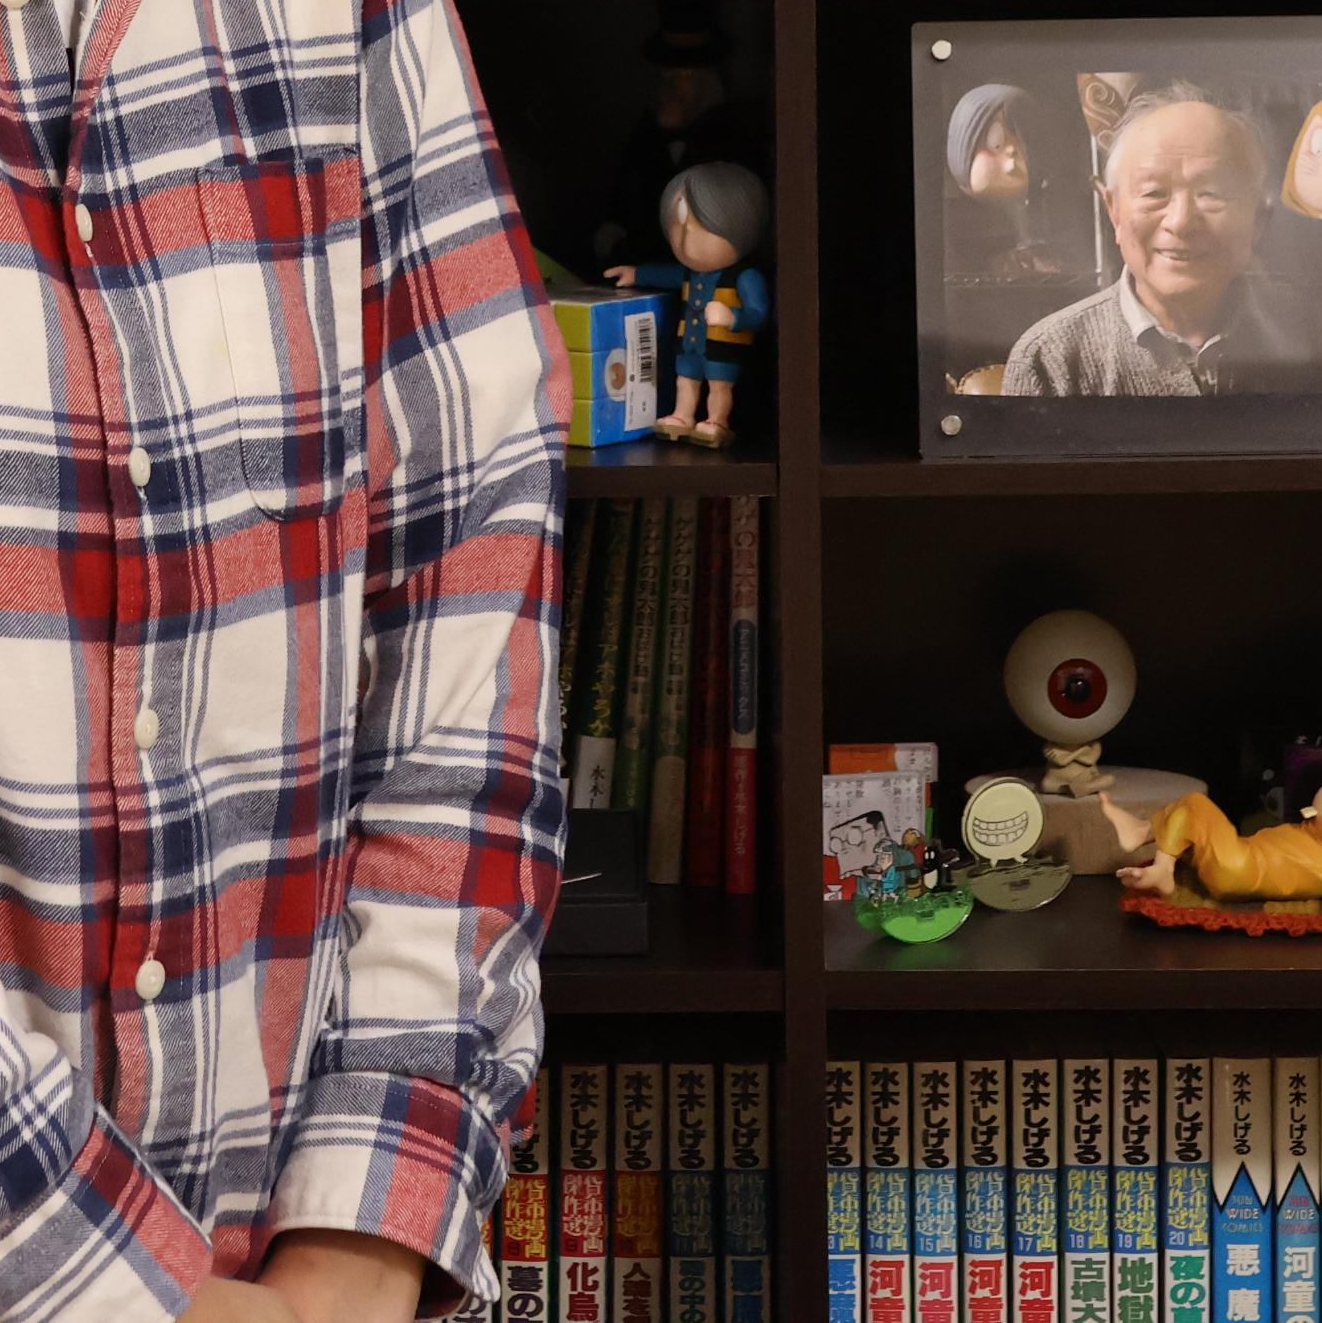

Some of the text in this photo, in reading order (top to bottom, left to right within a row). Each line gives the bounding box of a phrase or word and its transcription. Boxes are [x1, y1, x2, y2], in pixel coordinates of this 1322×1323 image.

[1175, 1064, 1204, 1161] 水木しげる
[1233, 1071, 1251, 1155] 水木しげる
